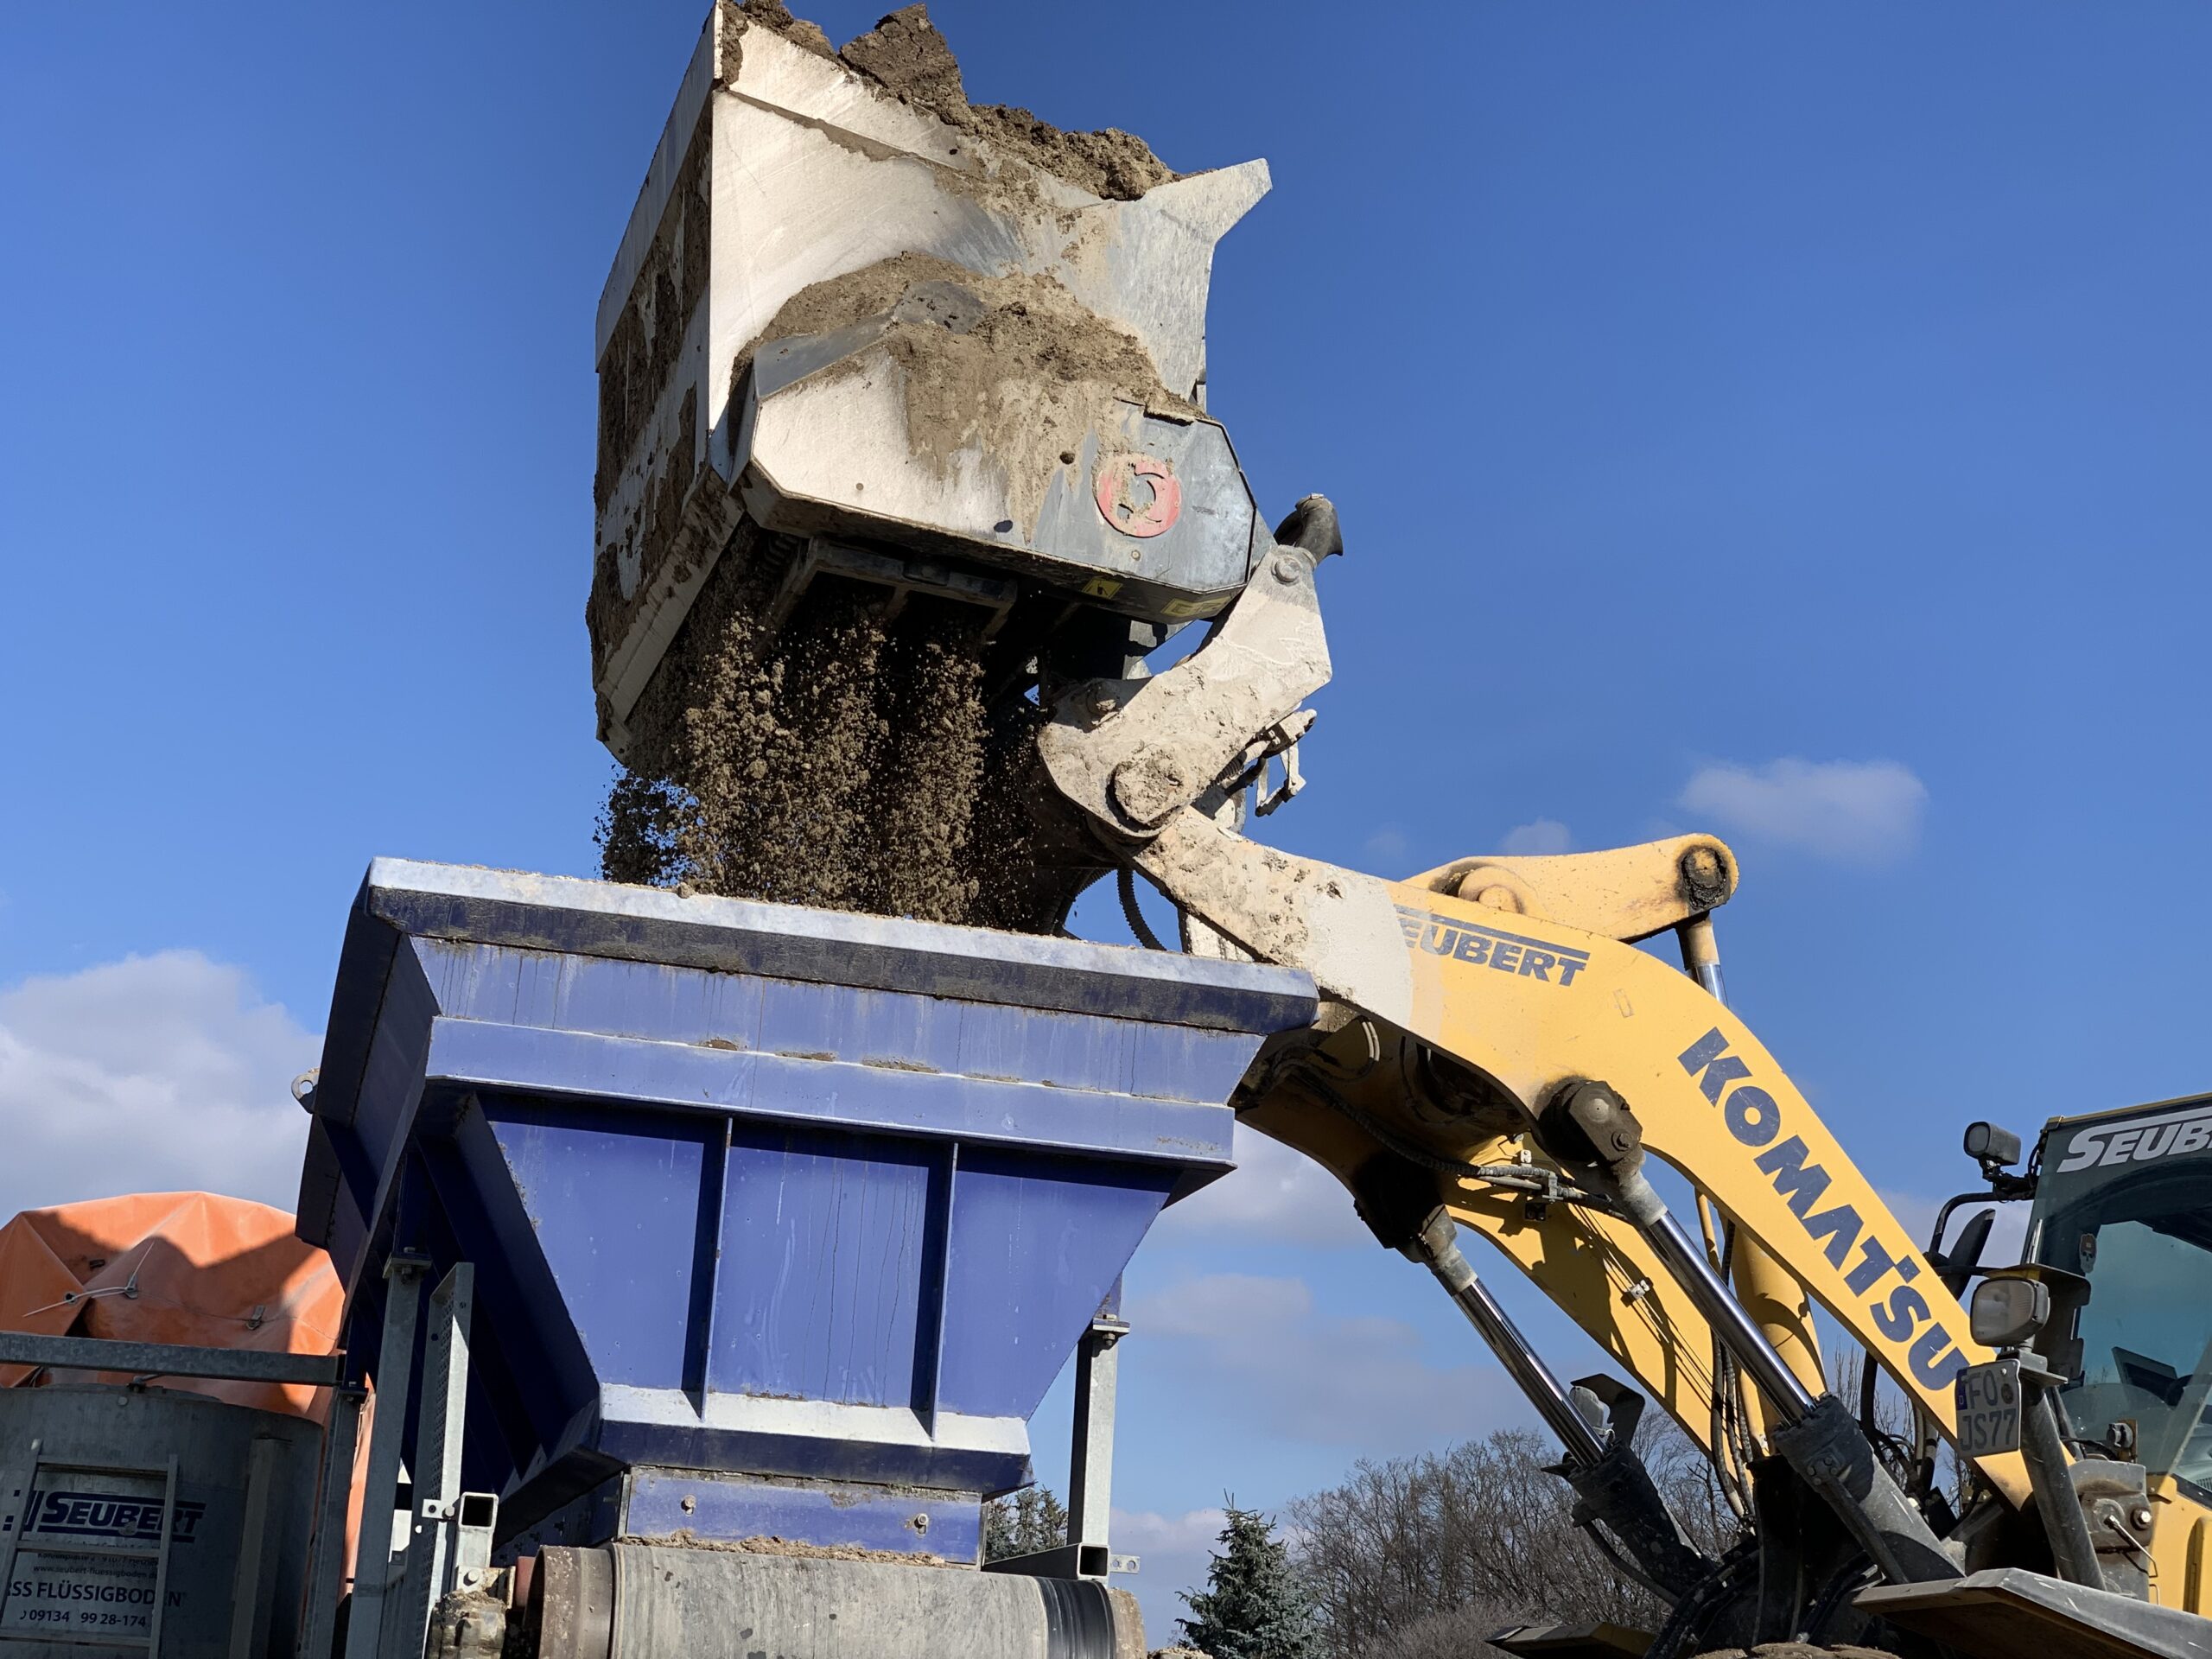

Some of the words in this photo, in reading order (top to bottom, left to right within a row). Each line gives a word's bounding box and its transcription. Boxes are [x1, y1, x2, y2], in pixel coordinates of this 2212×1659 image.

[1395, 914, 1588, 988] EUBERT
[2056, 1106, 2212, 1173] SEUB
[1677, 1026, 1970, 1391] KOMATSU
[1967, 1369, 1999, 1409] FO
[1959, 1408, 2018, 1452] JS77
[36, 1580, 181, 1607] FLÜSSIGBODN
[29, 1610, 70, 1623] 09134
[80, 1611, 97, 1624] 99
[99, 1613, 146, 1628] 28-174
